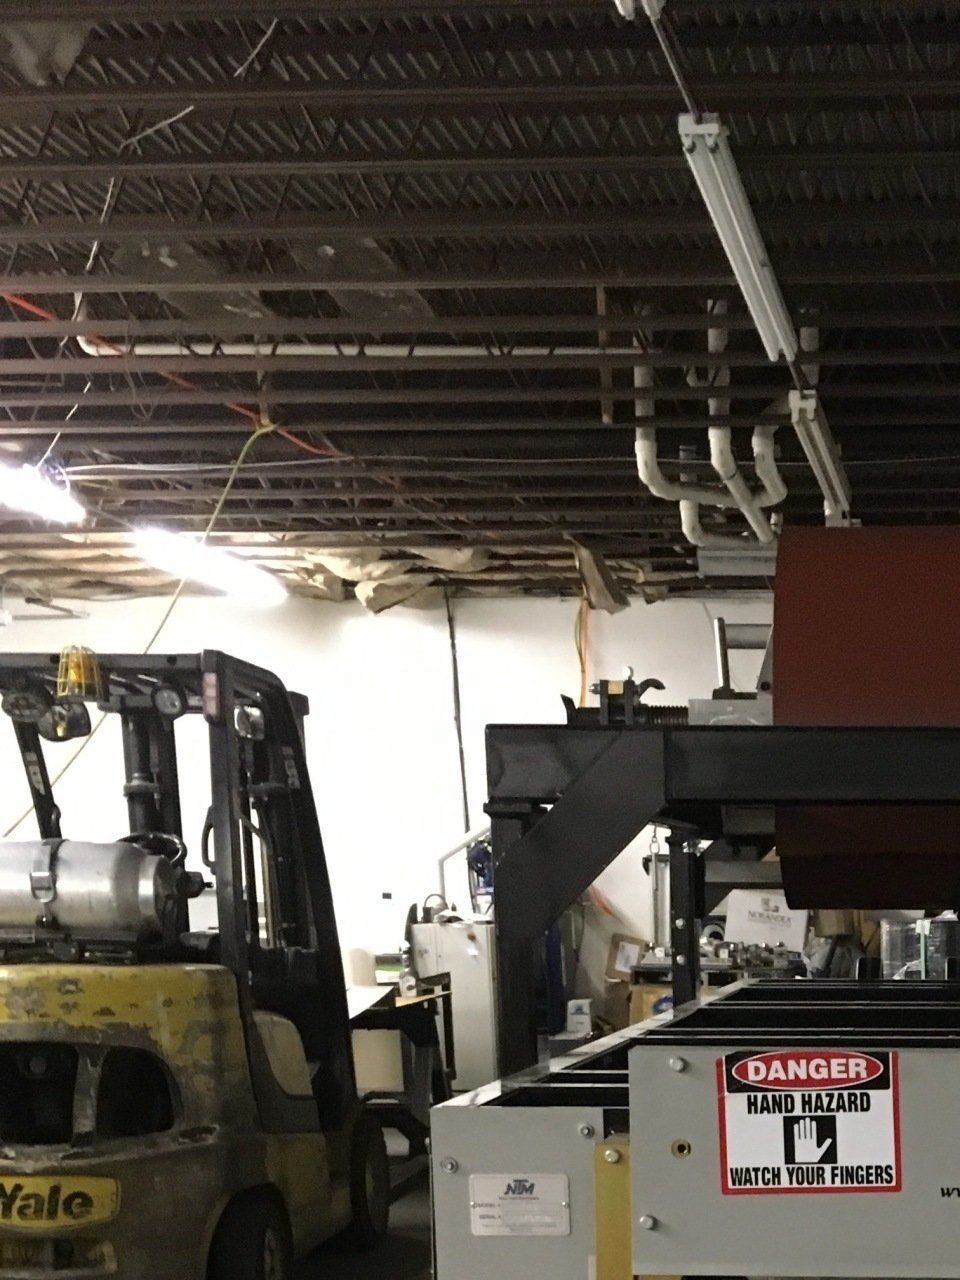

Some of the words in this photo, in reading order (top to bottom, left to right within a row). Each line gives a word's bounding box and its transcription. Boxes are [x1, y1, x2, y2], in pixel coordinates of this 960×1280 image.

[747, 1057, 868, 1081] DANGER
[747, 1093, 796, 1115] HAND
[801, 1091, 872, 1114] HAZARD
[503, 1179, 536, 1195] NTM
[729, 1166, 782, 1187] WATCH
[786, 1165, 826, 1186] YOUR
[831, 1164, 894, 1185] FINGERS
[0, 1182, 95, 1220] Yale
